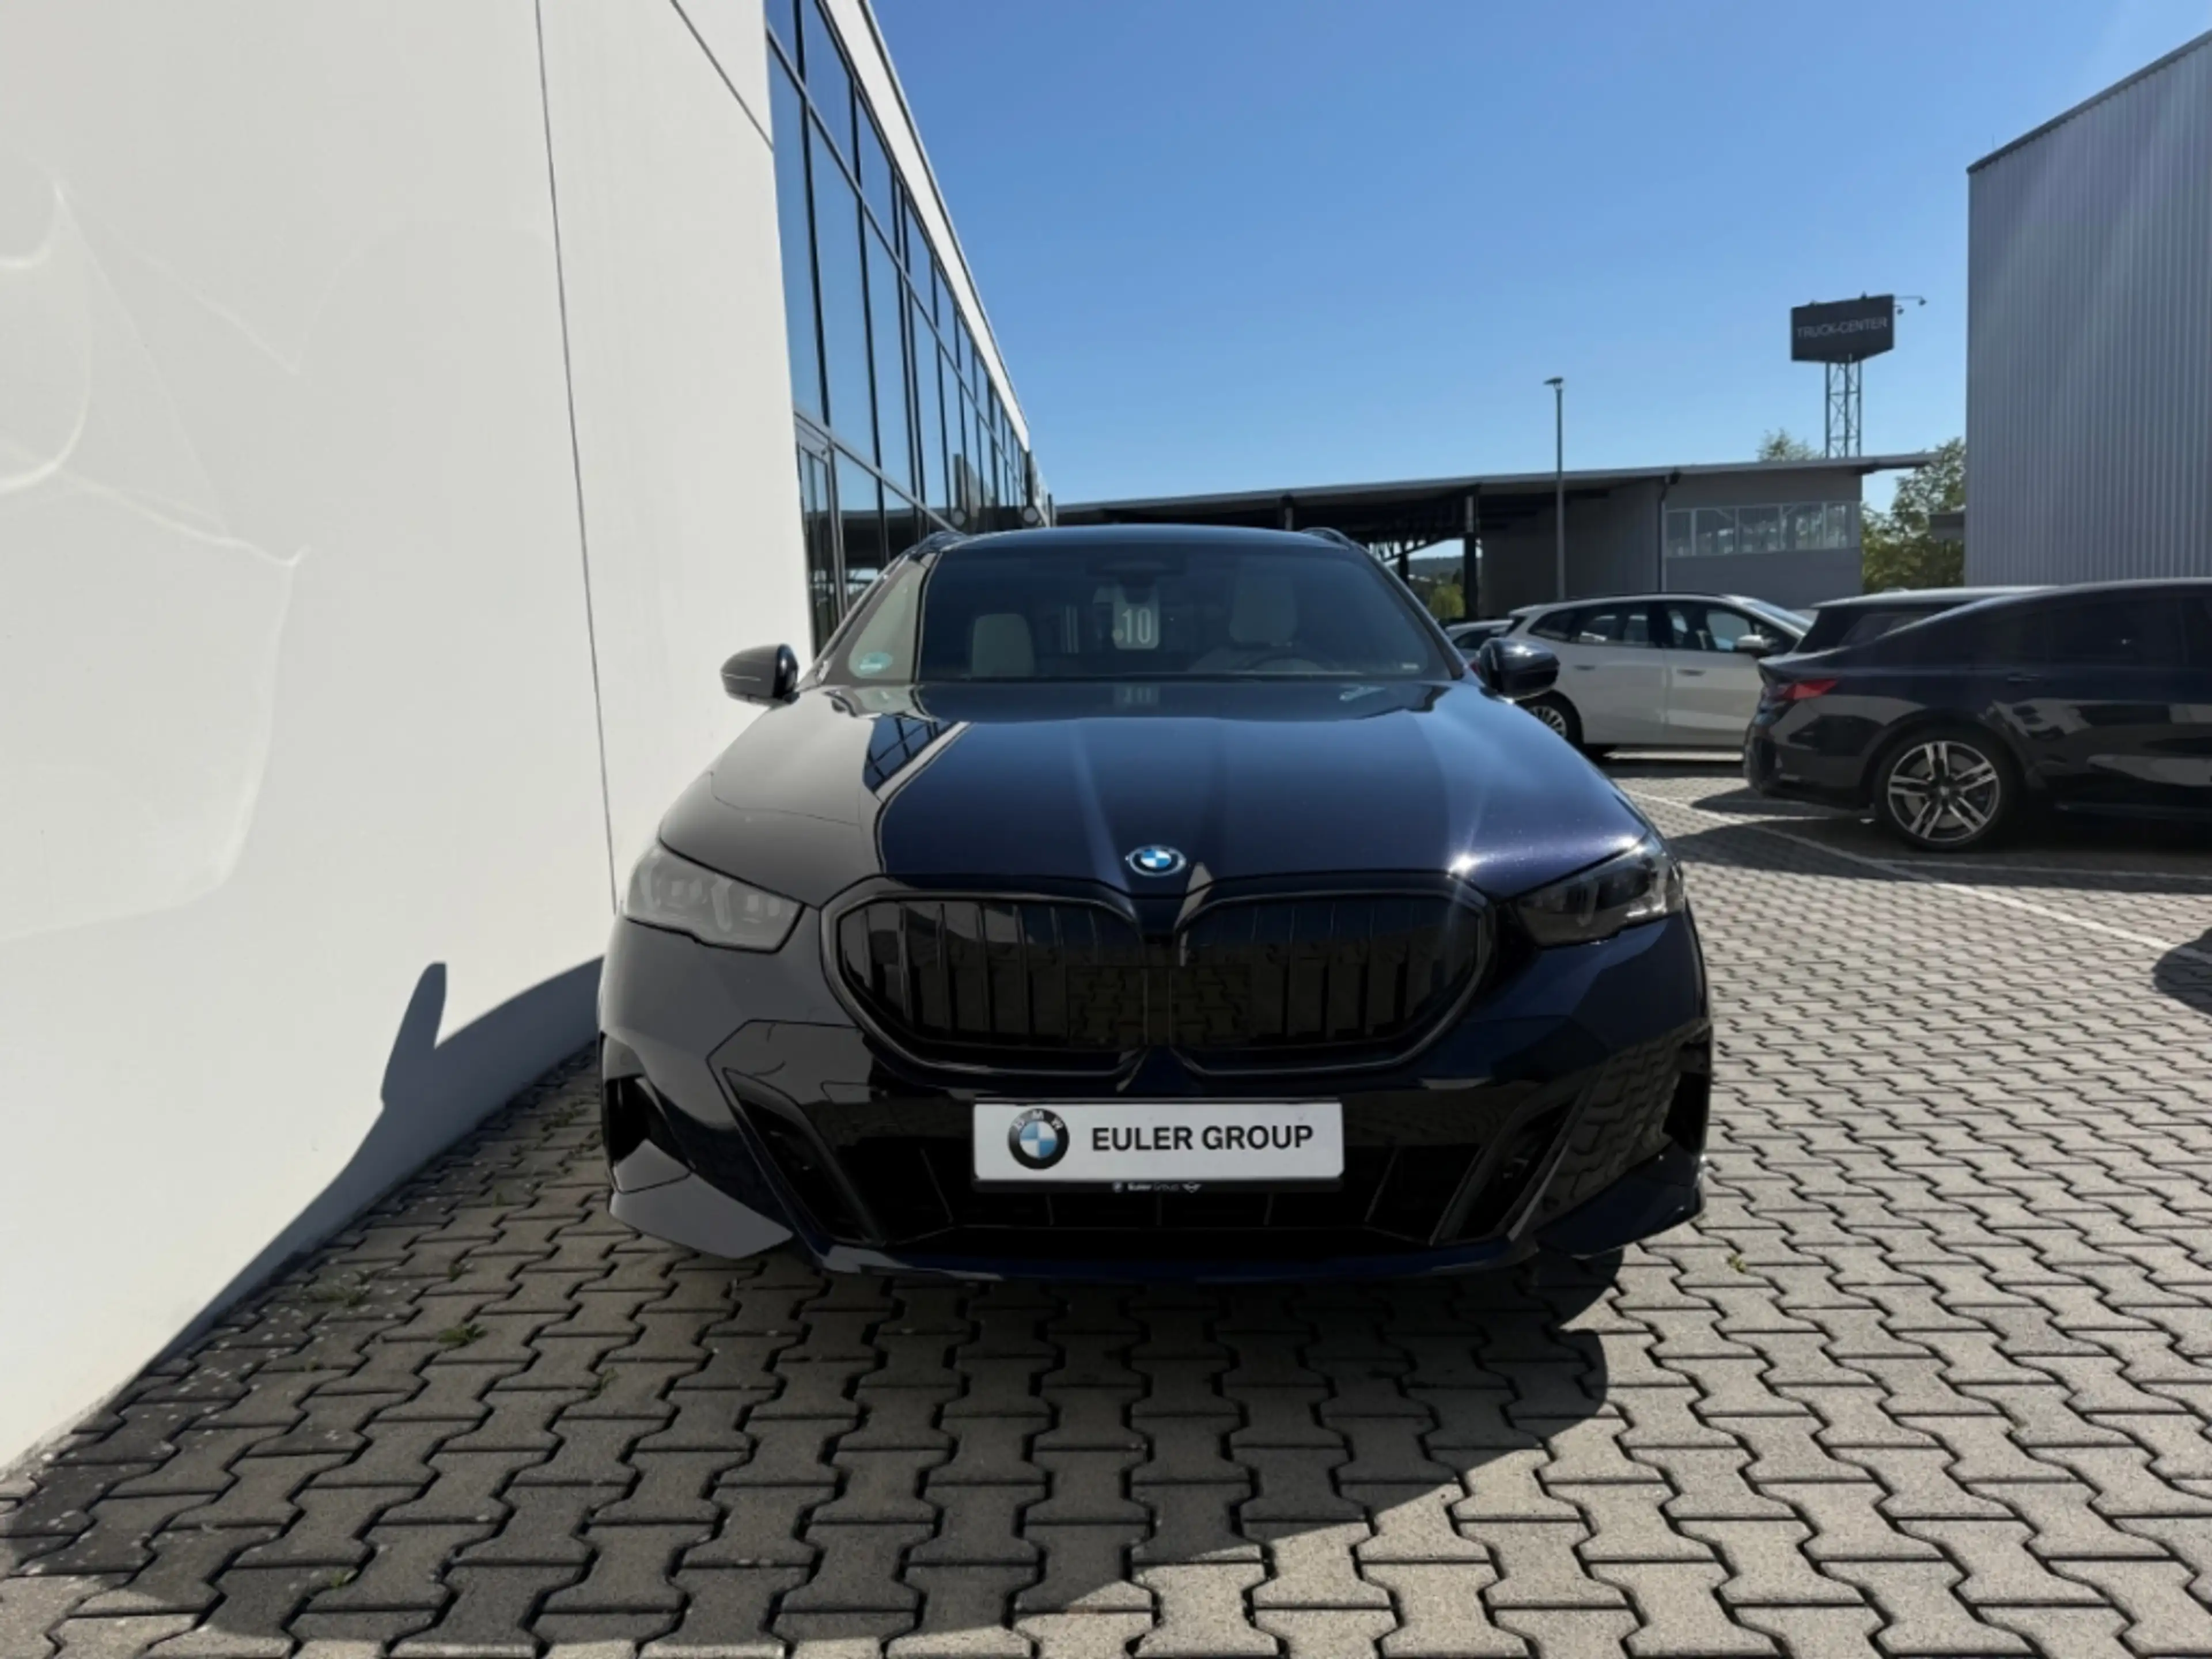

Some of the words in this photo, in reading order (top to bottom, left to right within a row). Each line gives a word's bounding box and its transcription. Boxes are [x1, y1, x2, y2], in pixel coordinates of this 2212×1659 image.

[1797, 317, 1888, 339] TRUCK-CENTER
[1122, 608, 1152, 645] 10
[1013, 1109, 1064, 1130] BMW
[1092, 1127, 1194, 1152] EULER
[1202, 1125, 1314, 1150] GROUP
